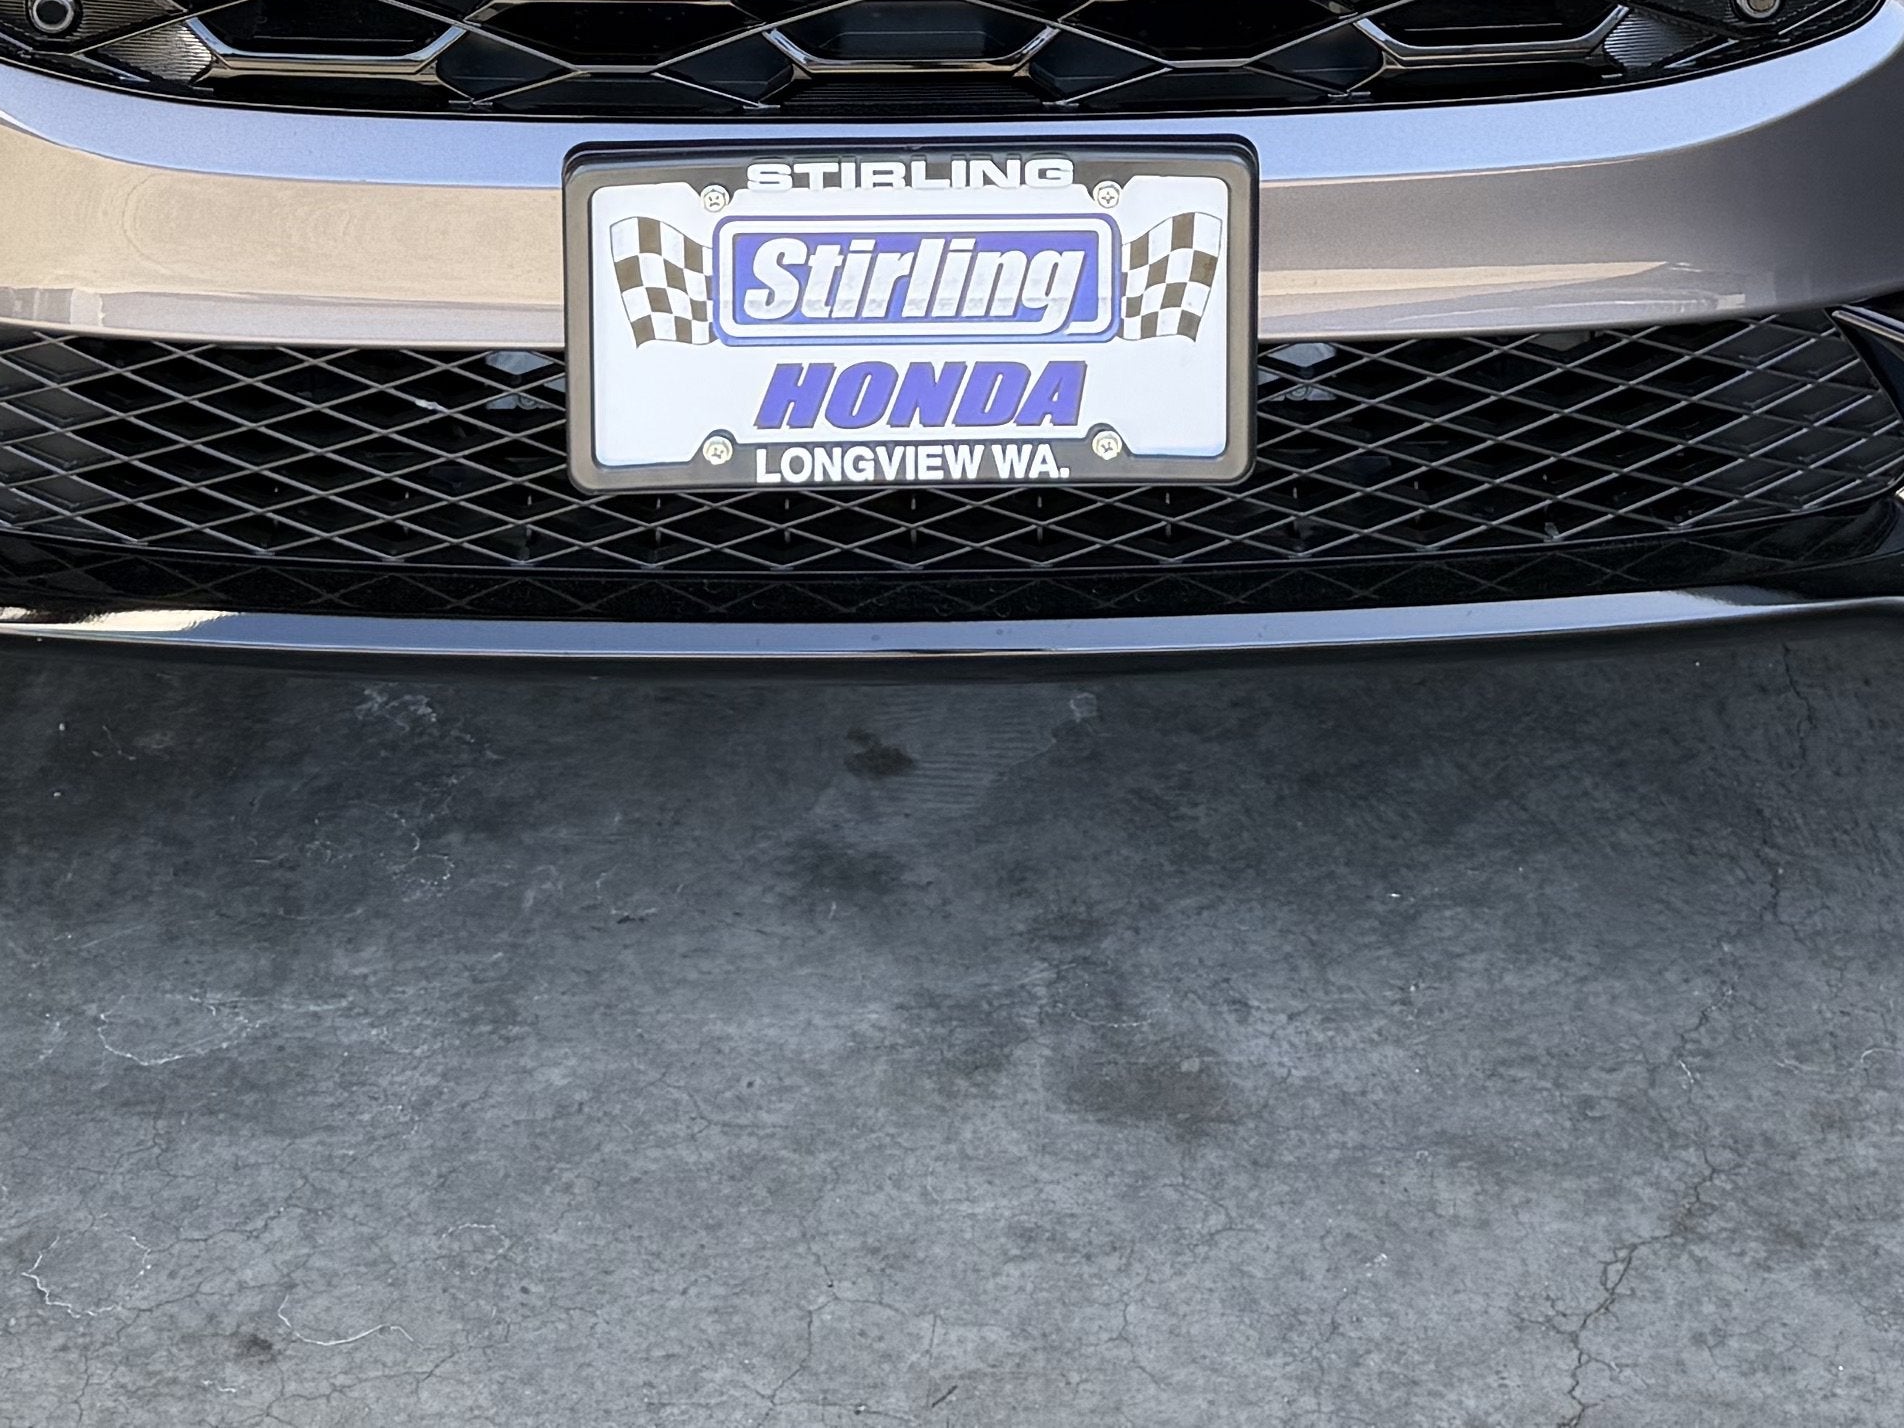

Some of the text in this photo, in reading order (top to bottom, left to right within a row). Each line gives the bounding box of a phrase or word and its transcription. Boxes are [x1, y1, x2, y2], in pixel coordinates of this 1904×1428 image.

[746, 157, 1075, 192] STIRLING
[744, 235, 1086, 332] Stirling
[754, 360, 1088, 430] HONDA
[756, 444, 1071, 484] LONGVIEW WA.
